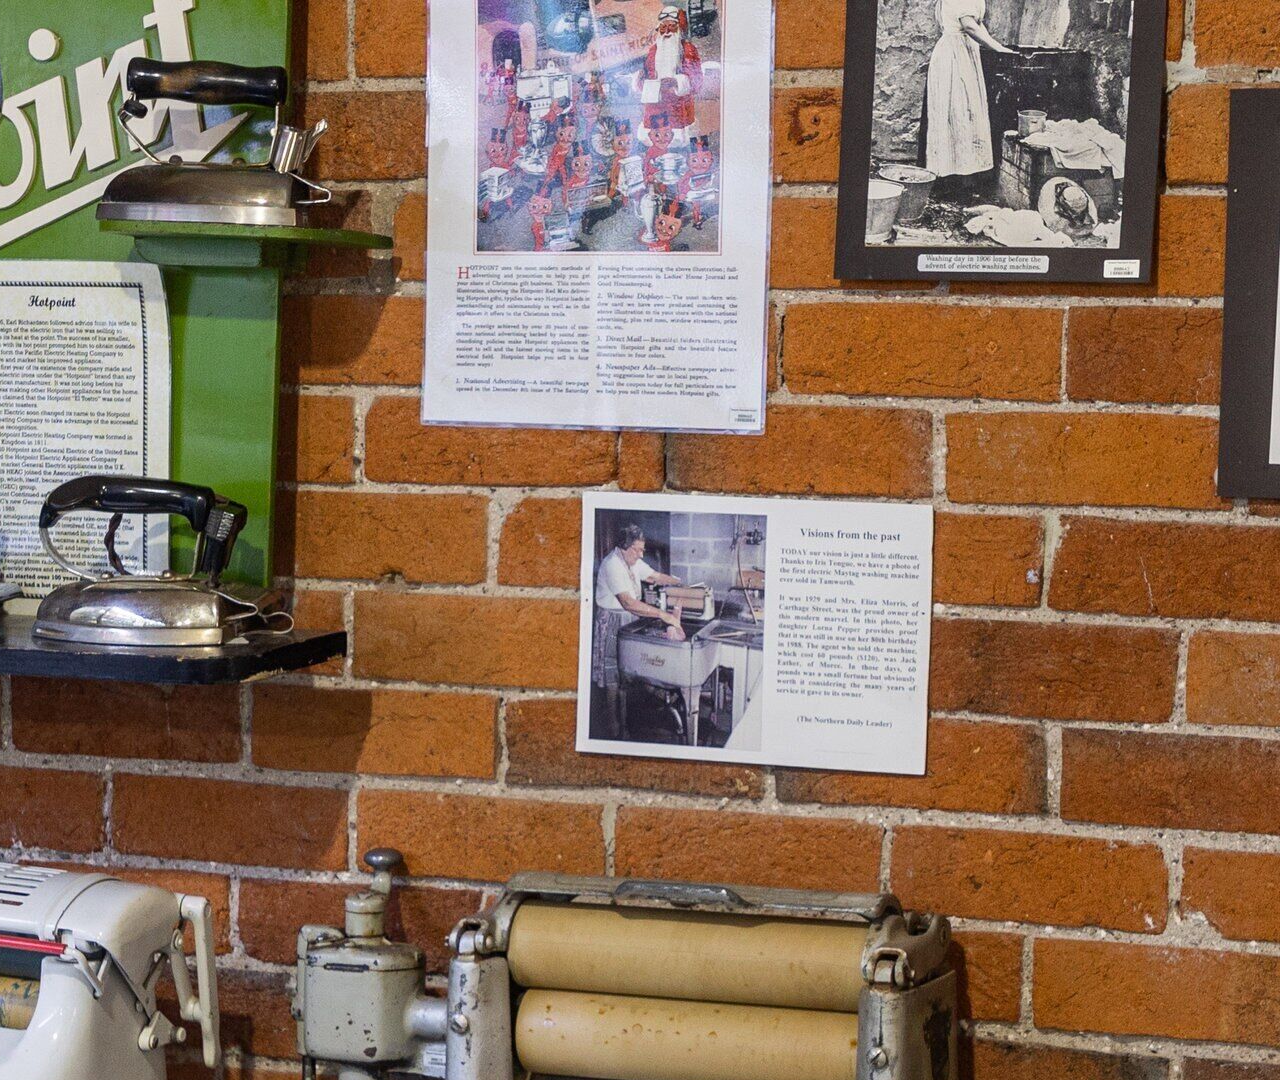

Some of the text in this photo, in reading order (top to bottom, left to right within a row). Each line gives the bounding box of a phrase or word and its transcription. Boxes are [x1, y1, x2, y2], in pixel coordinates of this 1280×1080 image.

[926, 255, 952, 263] Washing
[954, 255, 965, 263] day
[993, 255, 1006, 263] long
[981, 263, 1008, 271] washing
[28, 295, 76, 310] Hotpoint
[801, 528, 900, 544] Visions from the past
[851, 551, 863, 560] just
[834, 569, 859, 578] Maytag
[861, 570, 888, 579] washing
[891, 571, 919, 579] machine
[797, 715, 892, 729] (The Northern Daily Leader)
